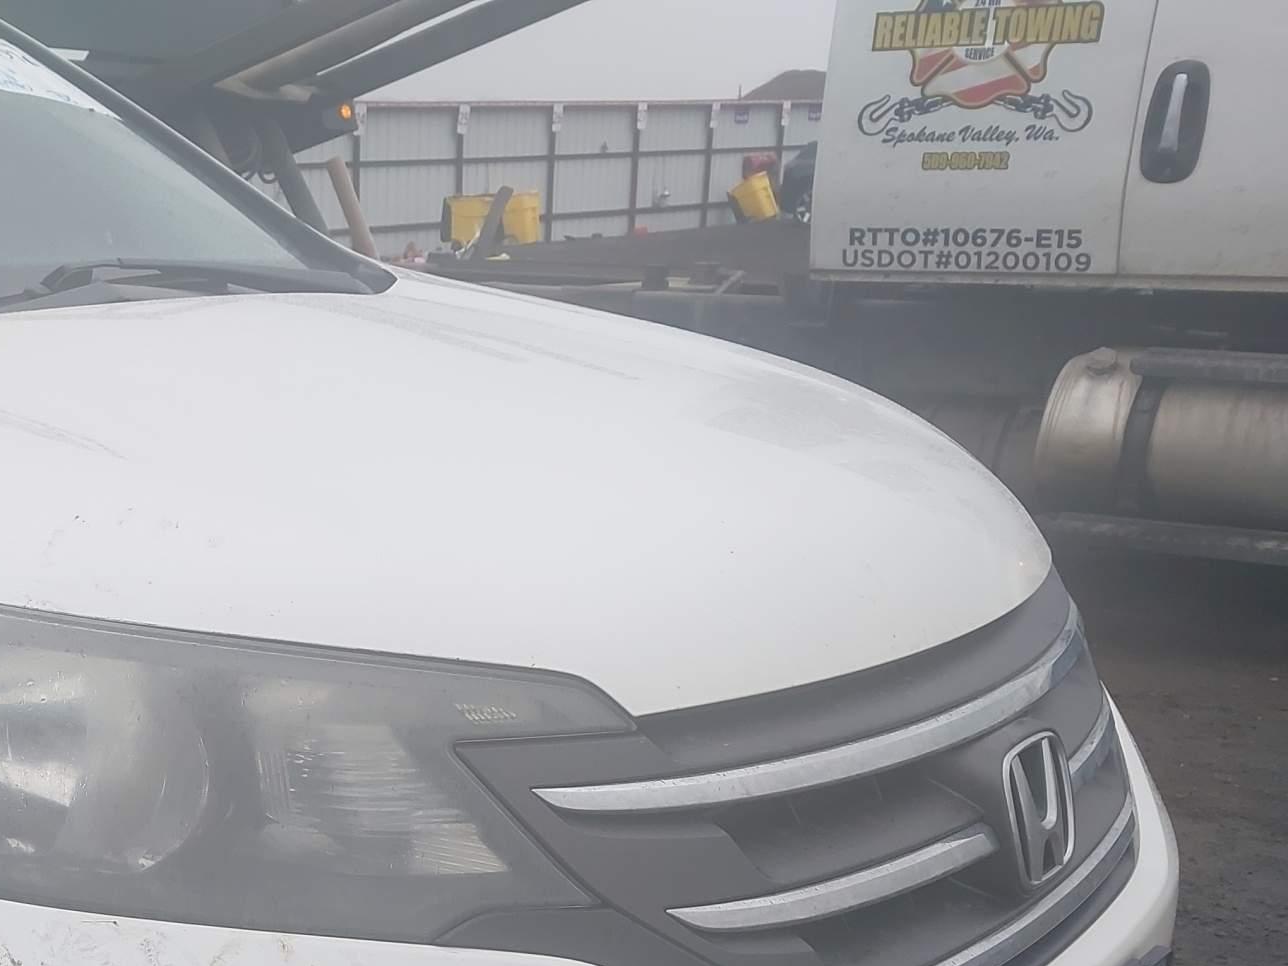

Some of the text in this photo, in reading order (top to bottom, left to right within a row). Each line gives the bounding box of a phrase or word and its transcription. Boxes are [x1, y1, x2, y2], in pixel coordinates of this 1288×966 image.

[873, 2, 1104, 50] RELIABLE TOWING
[965, 47, 995, 60] SERVICE
[881, 124, 1060, 147] Spokane Valley, Wa.
[848, 227, 1083, 249] RTTO#10676-E15
[842, 250, 1092, 272] USDOT#01200109
